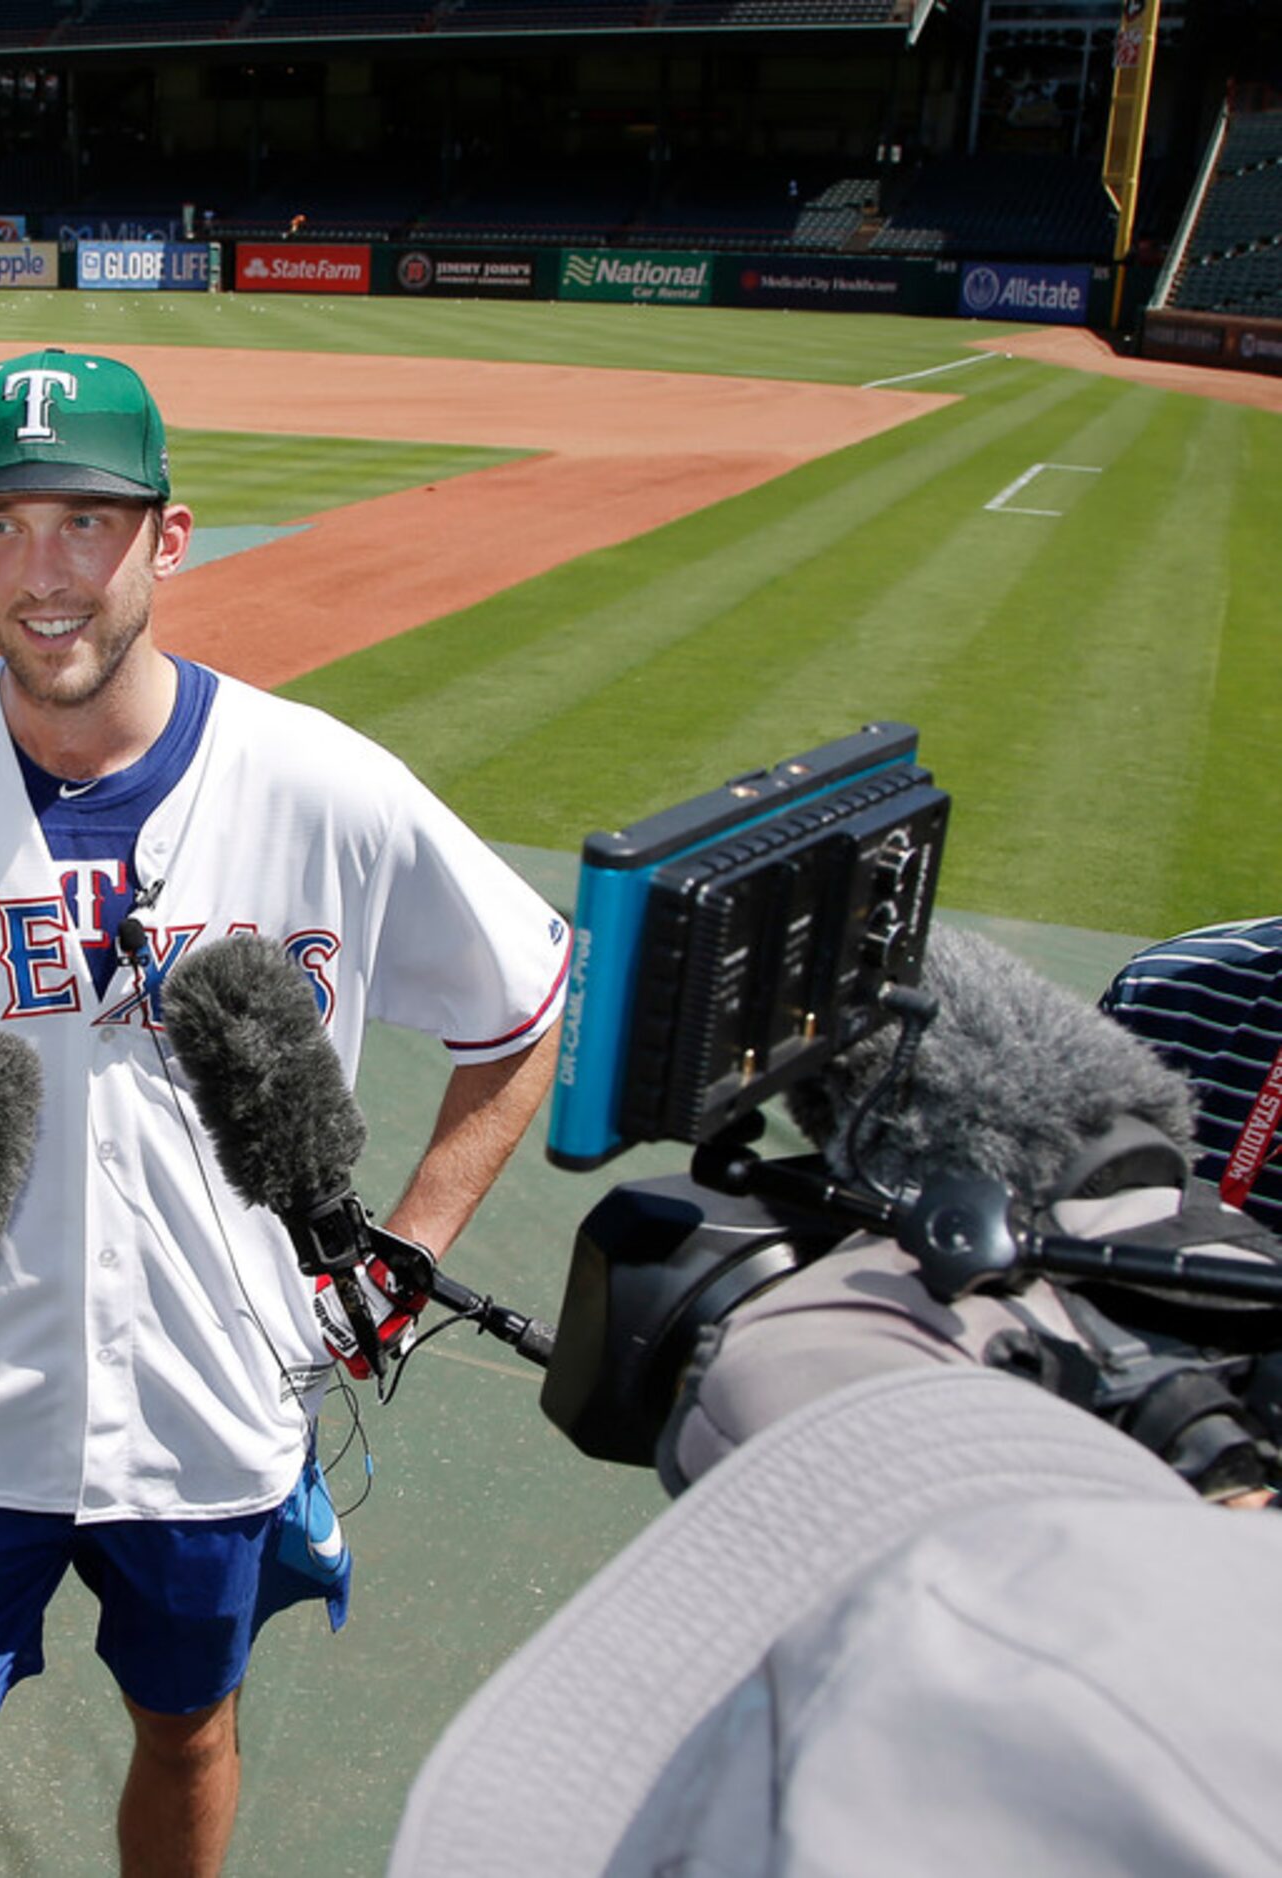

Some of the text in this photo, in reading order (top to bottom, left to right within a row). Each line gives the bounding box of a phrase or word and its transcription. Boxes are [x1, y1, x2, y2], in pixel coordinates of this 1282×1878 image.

[104, 252, 208, 281] GLOBE LIFE
[436, 261, 531, 277] JIMMY JOHN'S
[594, 258, 707, 286] National
[999, 278, 1081, 310] Allstate
[3, 369, 77, 444] T
[51, 859, 127, 949] T
[1228, 1092, 1281, 1181] STADIUM
